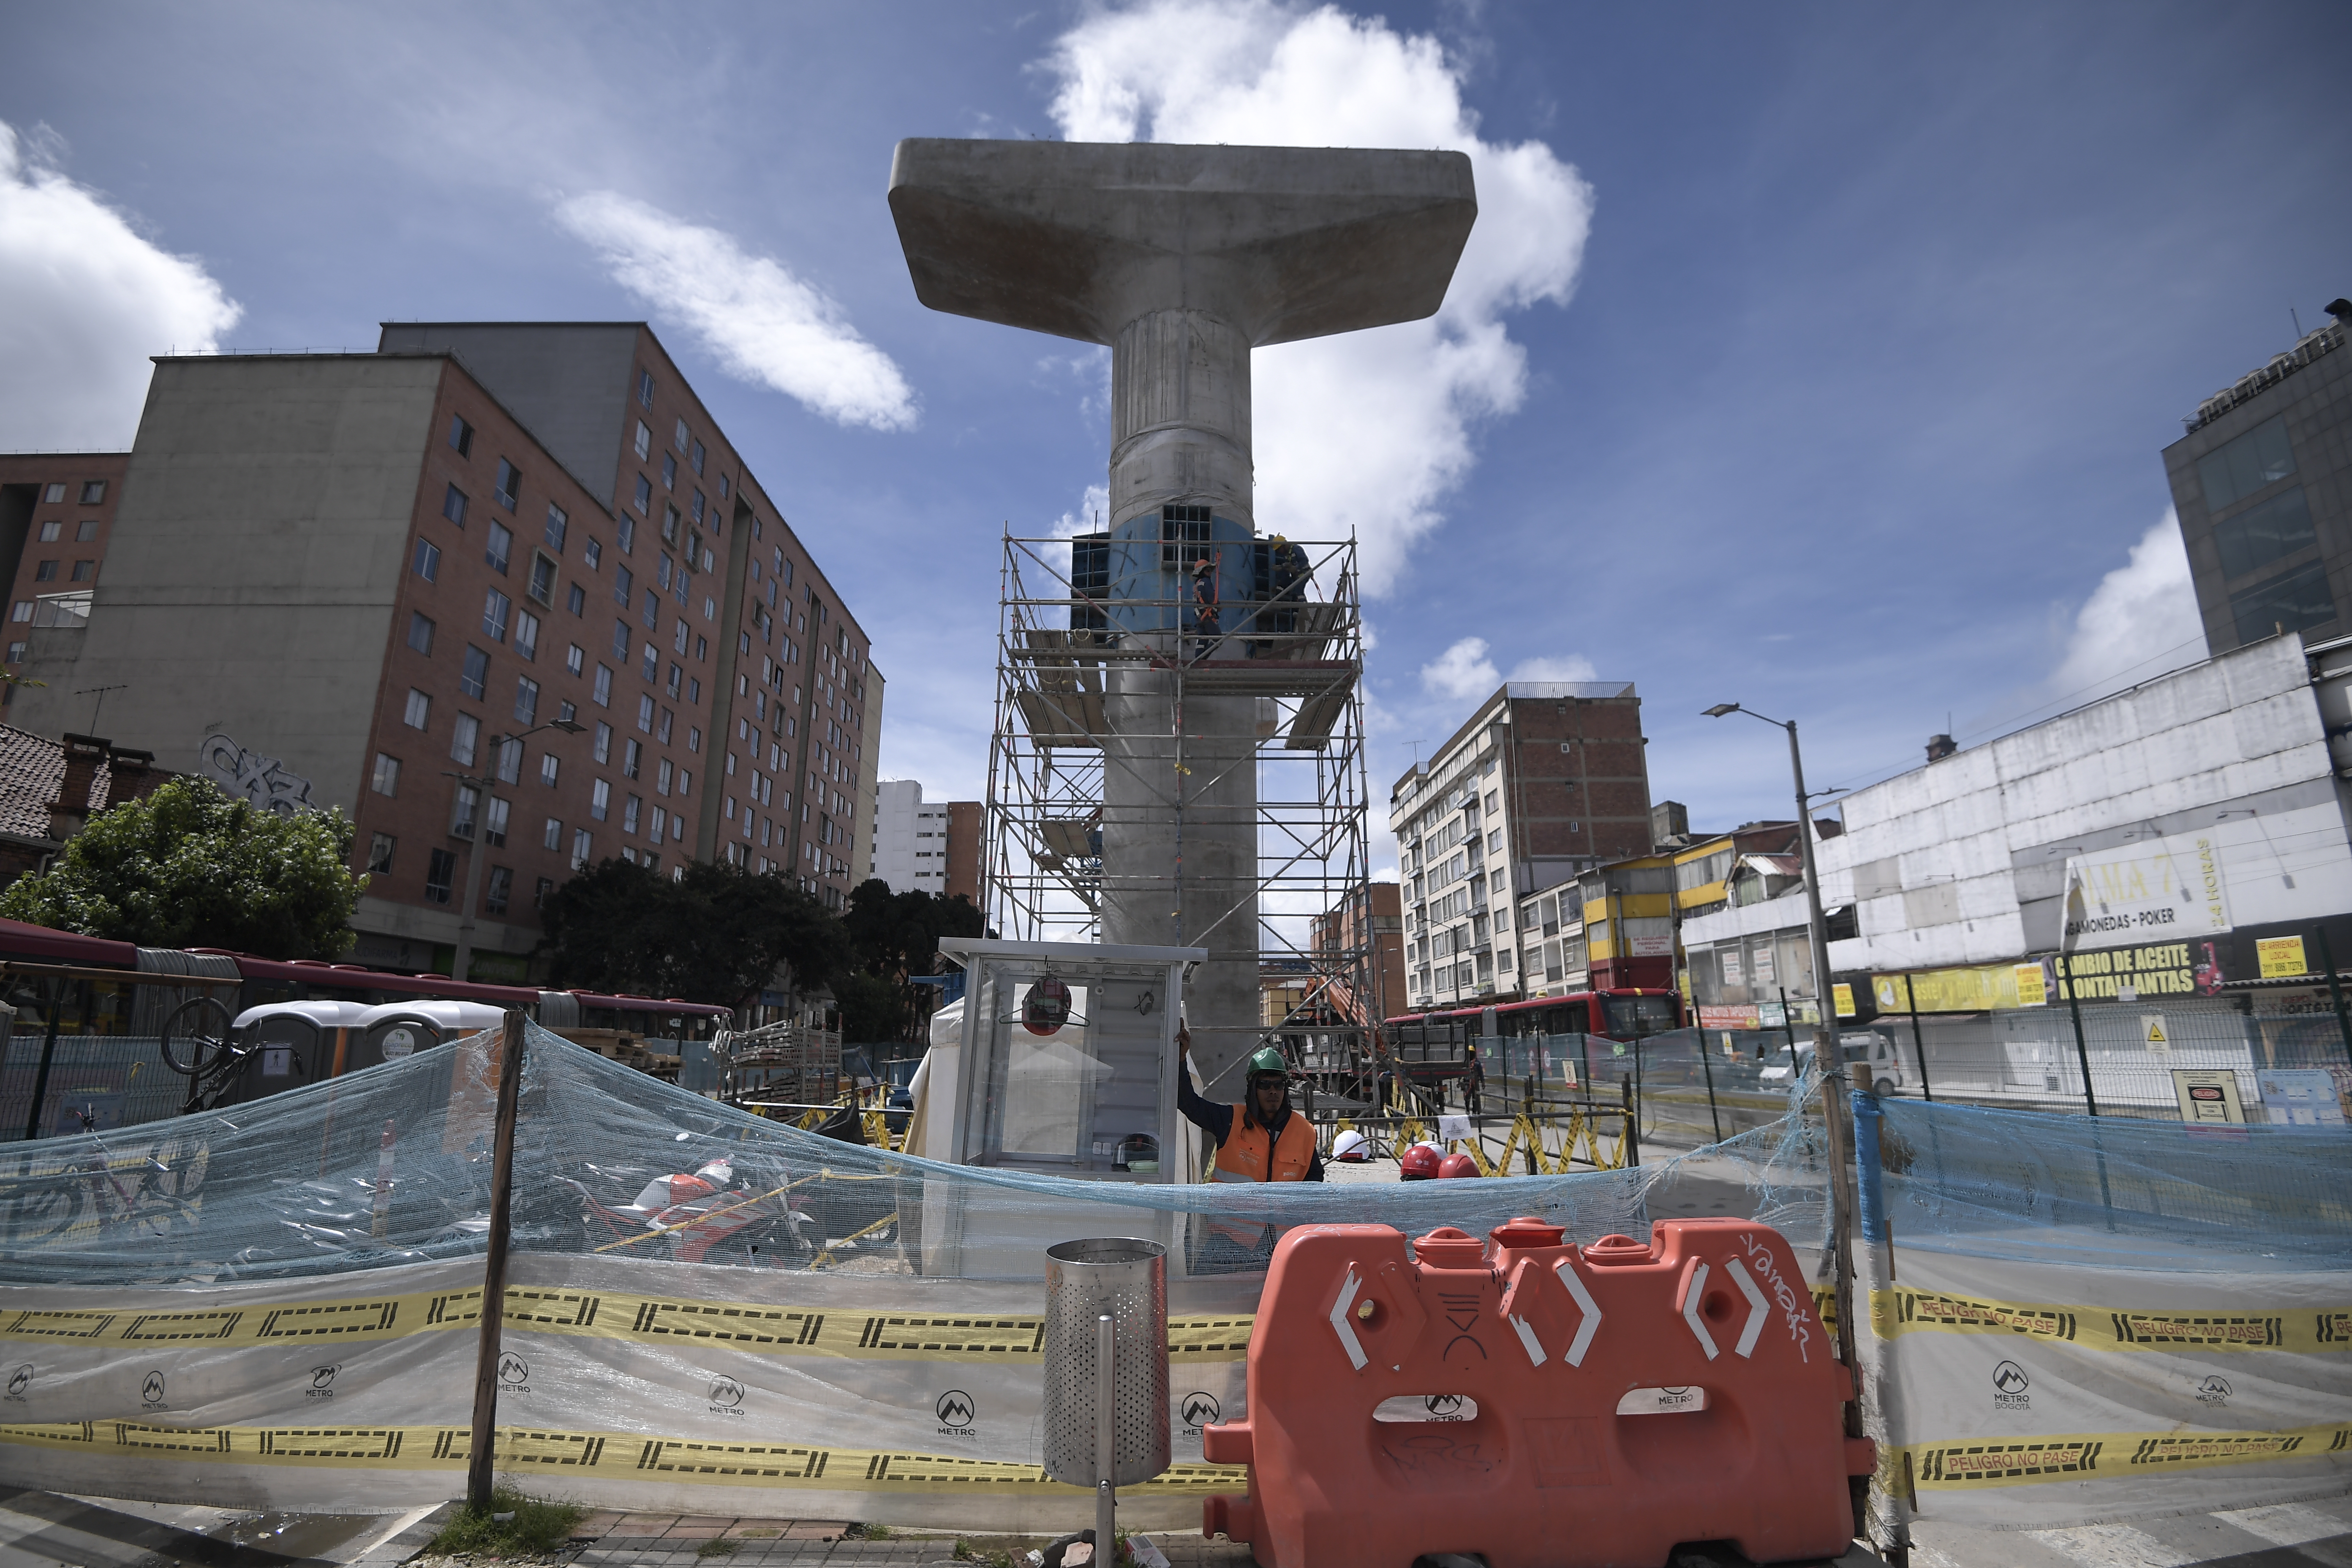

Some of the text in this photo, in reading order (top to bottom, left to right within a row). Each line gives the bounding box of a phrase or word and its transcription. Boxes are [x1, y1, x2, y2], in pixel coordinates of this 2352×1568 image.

[2197, 838, 2220, 901] HORAS
[2065, 913, 2130, 936] GAMONEDAS
[2138, 907, 2175, 927] POKER
[352, 945, 398, 961] AUDIFARMA
[2113, 949, 2133, 972] DE
[2134, 942, 2191, 971] ACEITE
[1894, 977, 1943, 1002] Braster
[1921, 1301, 2055, 1333] PELIGR NO PASE
[2133, 1322, 2265, 1339] PELIGRO NO PASE
[498, 1384, 531, 1393] METRO
[1658, 1394, 1693, 1405] METRO
[1994, 1393, 2030, 1403] METRO
[709, 1406, 745, 1416] METRO
[938, 1427, 976, 1436] METRO
[2223, 1444, 2243, 1454] NO
[1948, 1450, 2080, 1472] PELIGRO NO PASE
